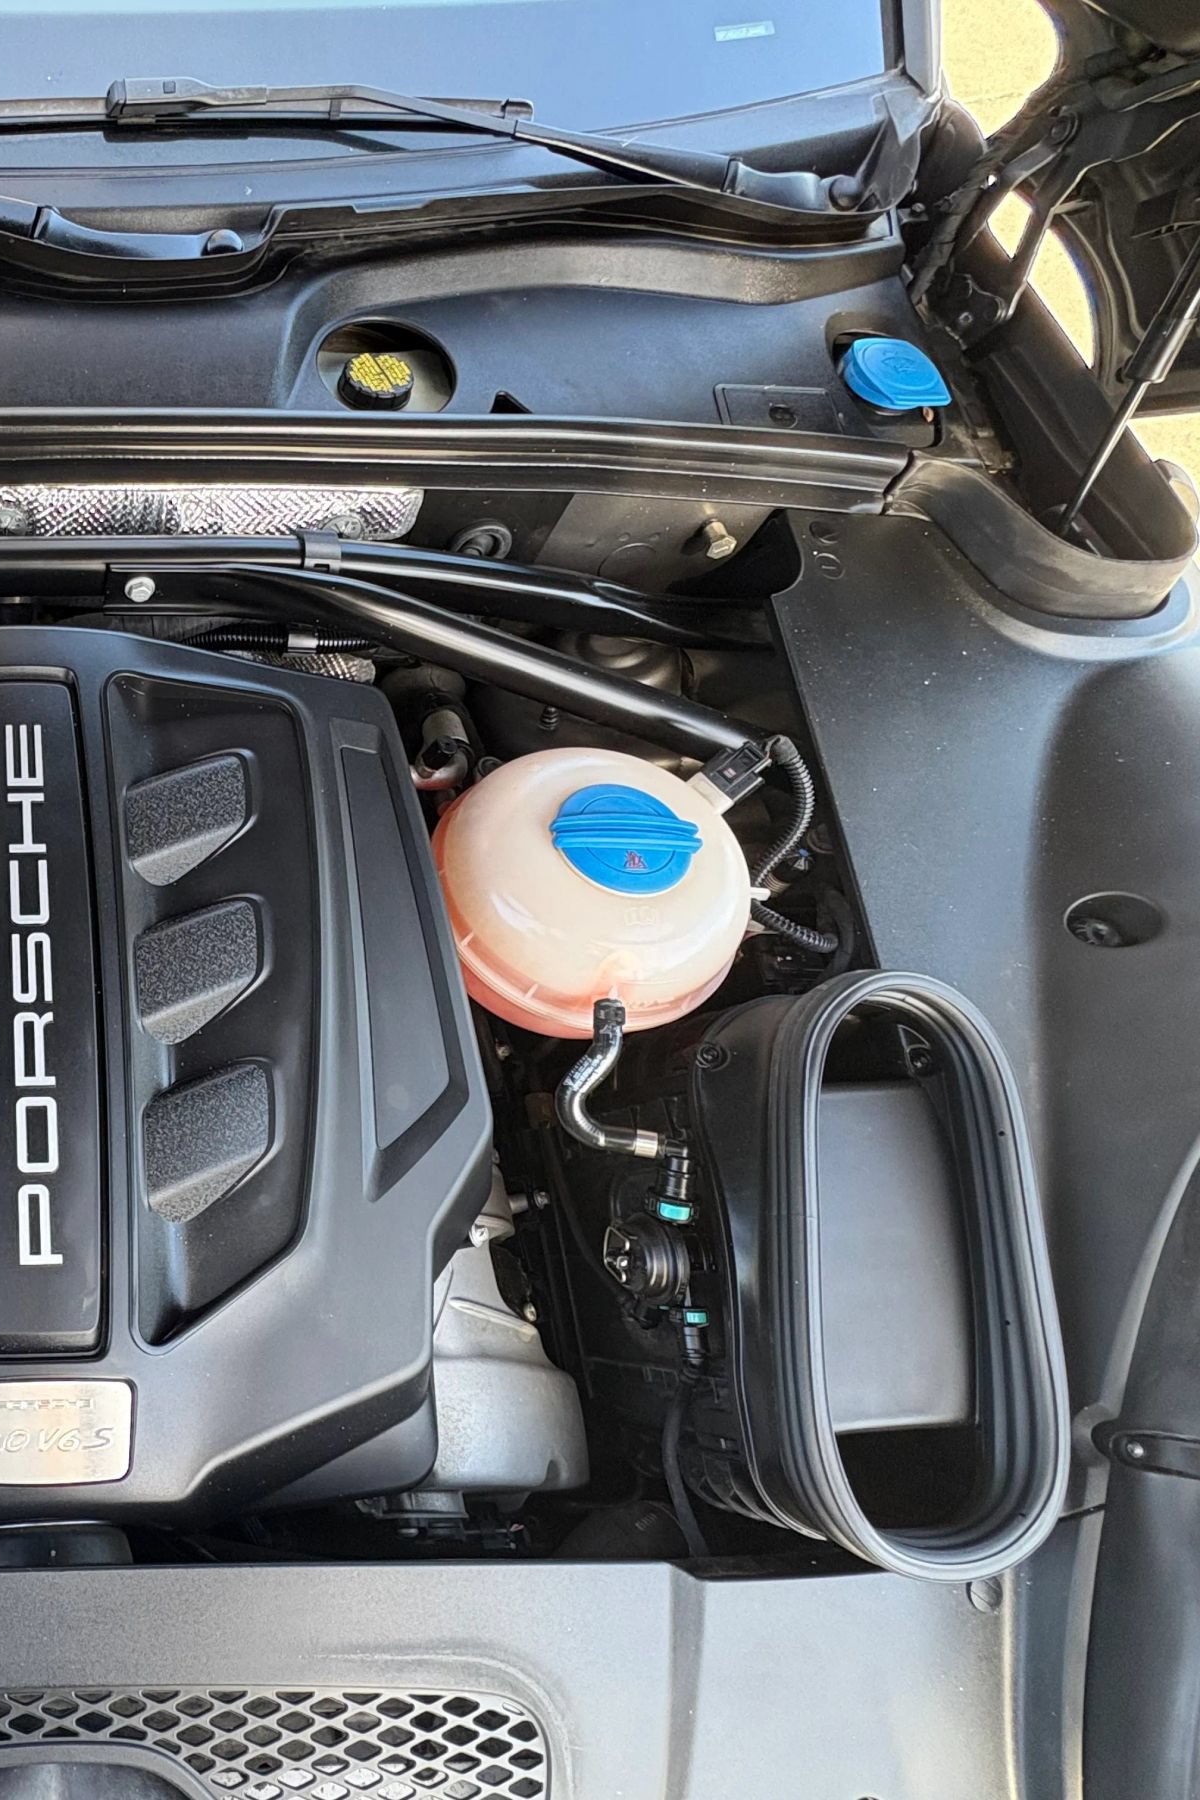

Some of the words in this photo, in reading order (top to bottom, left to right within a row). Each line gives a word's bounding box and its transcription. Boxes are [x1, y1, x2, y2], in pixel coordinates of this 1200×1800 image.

[4, 723, 64, 1267] PORSCHE
[36, 1428, 82, 1453] V6
[81, 1426, 116, 1451] S
